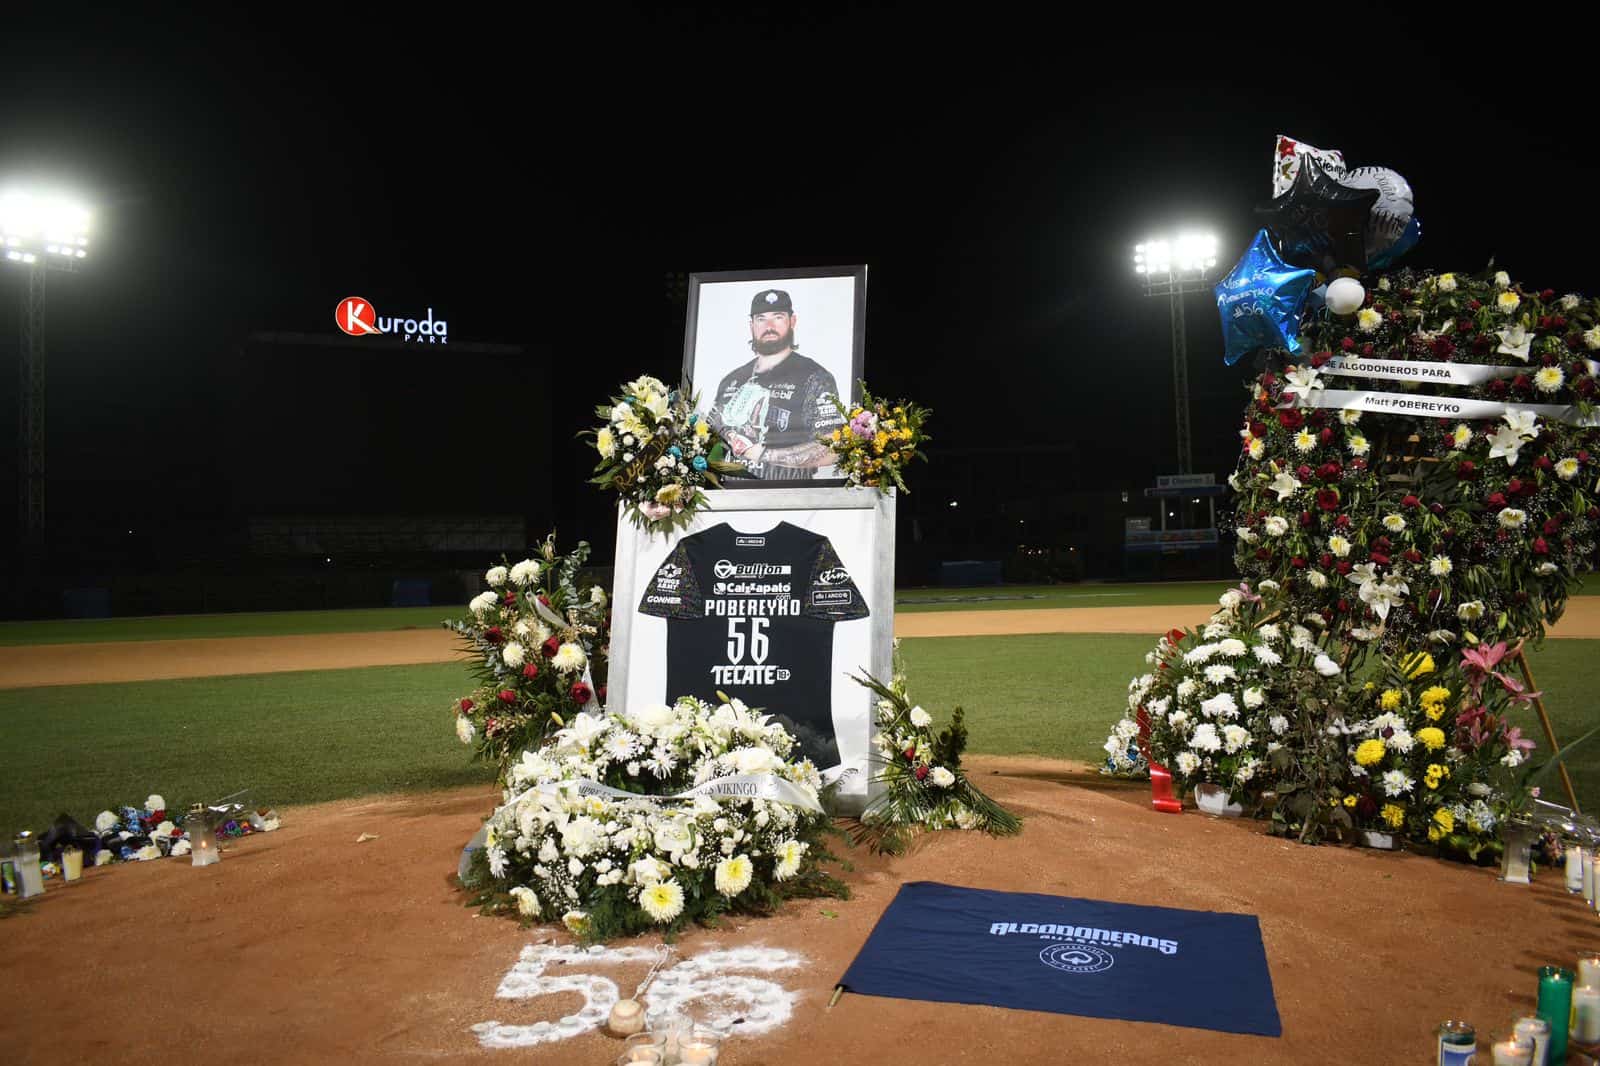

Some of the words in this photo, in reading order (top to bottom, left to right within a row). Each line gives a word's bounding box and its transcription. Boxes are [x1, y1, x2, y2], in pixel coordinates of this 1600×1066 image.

[346, 301, 448, 335] Kuroda
[405, 335, 447, 344] PARK
[1338, 362, 1419, 376] ALGODONEROS
[1421, 368, 1452, 379] PARA
[1391, 399, 1461, 414] POBEREYKO
[727, 617, 770, 665] 56
[710, 665, 778, 685] TECATE
[717, 782, 758, 796] VIKINGO
[990, 922, 1178, 954] ALGODONEROS
